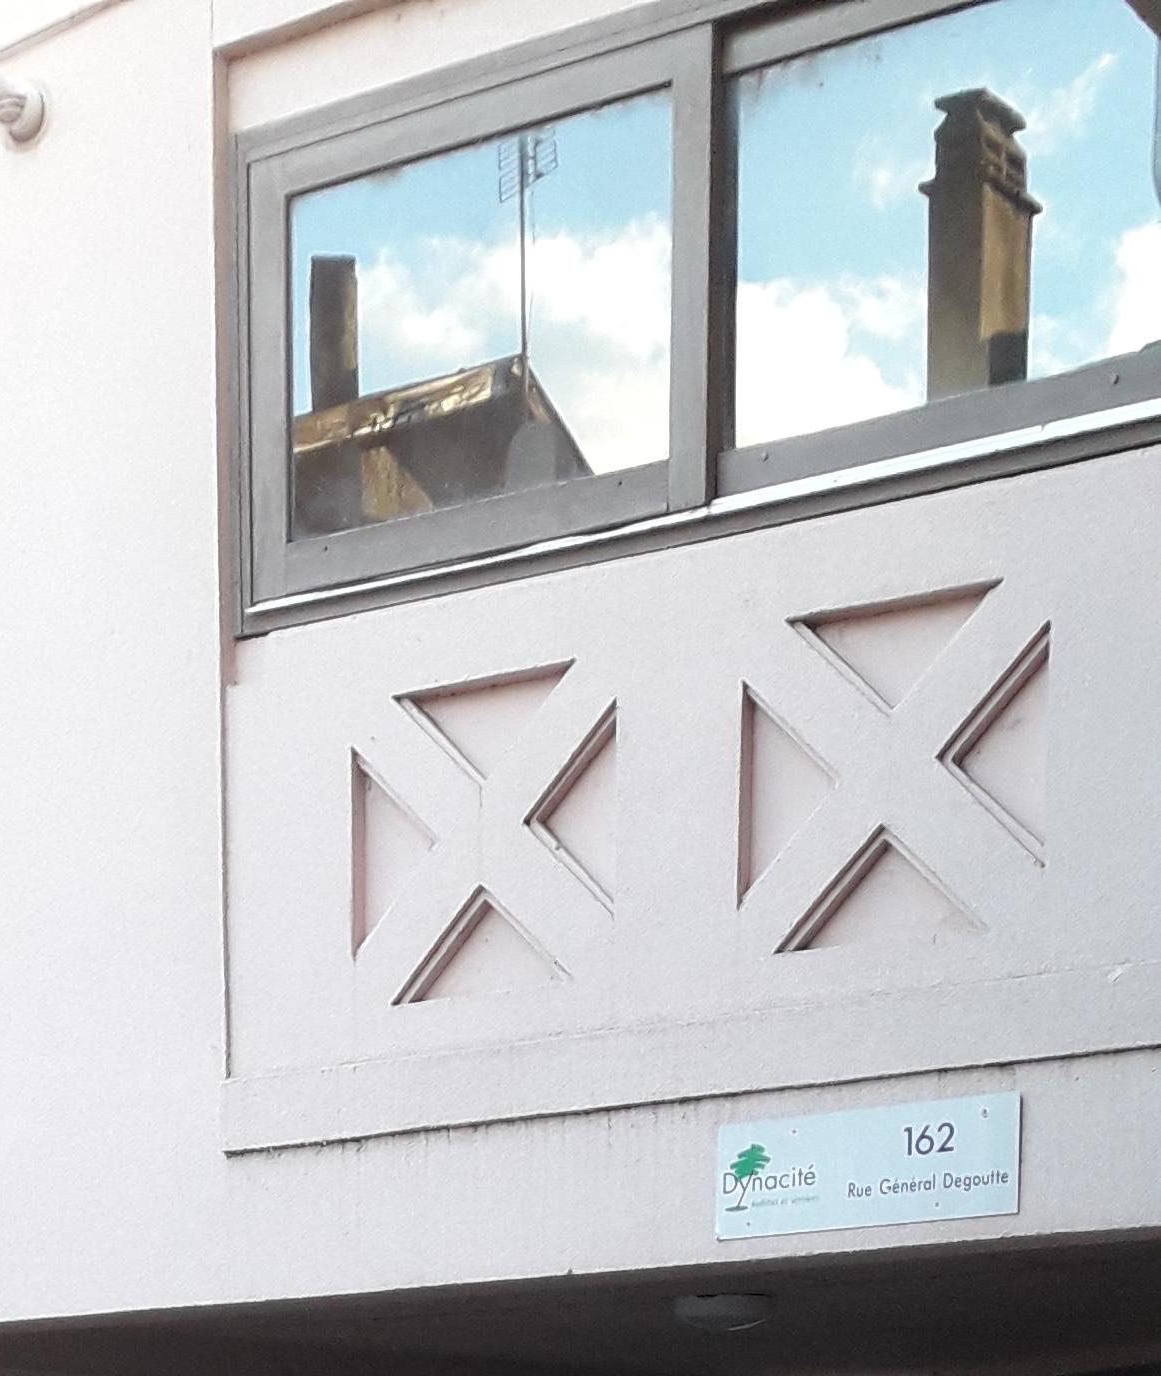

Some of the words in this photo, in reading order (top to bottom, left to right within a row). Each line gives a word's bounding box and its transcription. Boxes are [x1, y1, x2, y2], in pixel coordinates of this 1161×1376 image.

[903, 1122, 955, 1156] 162
[722, 1164, 816, 1207] Dynacité
[847, 1182, 872, 1198] Rue
[879, 1173, 936, 1195] Général
[943, 1170, 1009, 1192] Degoutte
